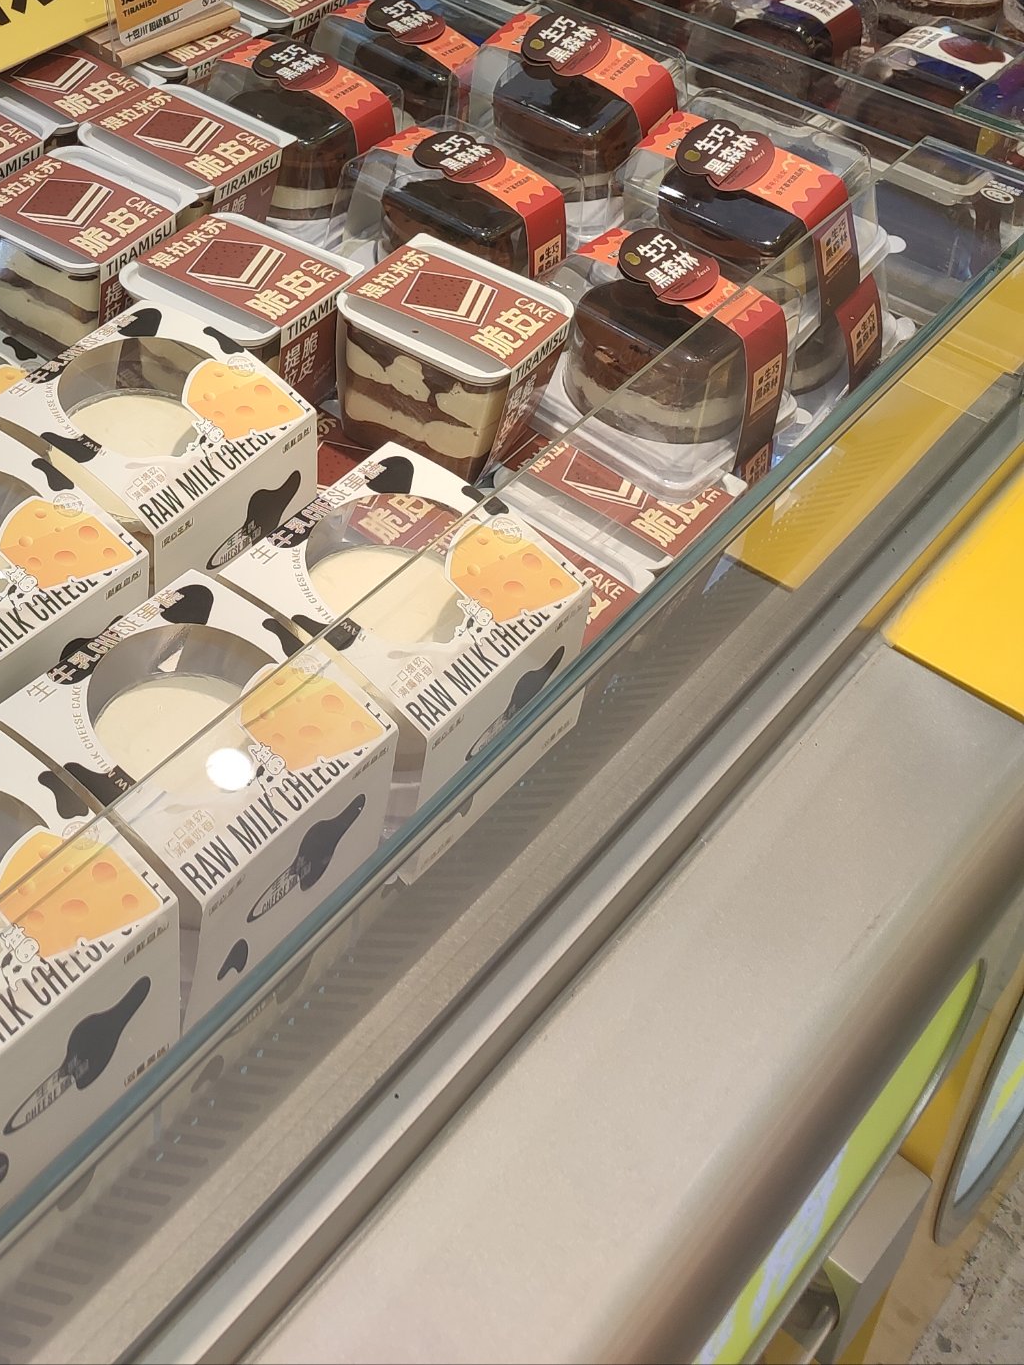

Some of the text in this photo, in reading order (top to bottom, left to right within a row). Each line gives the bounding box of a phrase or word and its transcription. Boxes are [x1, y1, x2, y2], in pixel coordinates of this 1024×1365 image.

[381, 0, 416, 20] 生巧
[386, 9, 435, 35] 黑森林
[538, 14, 577, 44] 生巧
[270, 44, 306, 64] 生巧
[546, 25, 598, 64] 黑森林
[107, 72, 140, 94] CAKE
[275, 53, 327, 81] 黑森林
[54, 79, 124, 119] 脆皮
[100, 90, 173, 132] 提拉米苏
[235, 131, 271, 152] CAKE
[432, 134, 471, 156] 生巧
[440, 144, 494, 173] 黑森林
[694, 123, 736, 155] 生巧
[704, 133, 760, 177] 黑森林
[185, 139, 259, 182] 脆皮
[218, 154, 280, 201] TIRAMISU
[125, 196, 163, 220] CAKE
[69, 204, 143, 259] 脆皮
[105, 223, 176, 276] TIRAMISU
[147, 217, 228, 270] 提拉米苏
[637, 233, 677, 266] 生巧
[298, 260, 340, 282] CAKE
[357, 249, 432, 300] 提拉米苏
[645, 245, 702, 290] 黑森林
[244, 270, 325, 321] 脆皮
[286, 292, 339, 338] TIRAMIS
[514, 297, 556, 323] CAKE
[471, 304, 544, 359] 脆皮
[514, 326, 569, 383] TIRAMISU
[138, 480, 184, 530] RAW
[184, 454, 225, 501] MILK
[581, 567, 626, 601] CAKE
[406, 675, 462, 732] RAW
[448, 644, 498, 699] MILK
[181, 836, 237, 896] RAW
[227, 799, 289, 854] MILK
